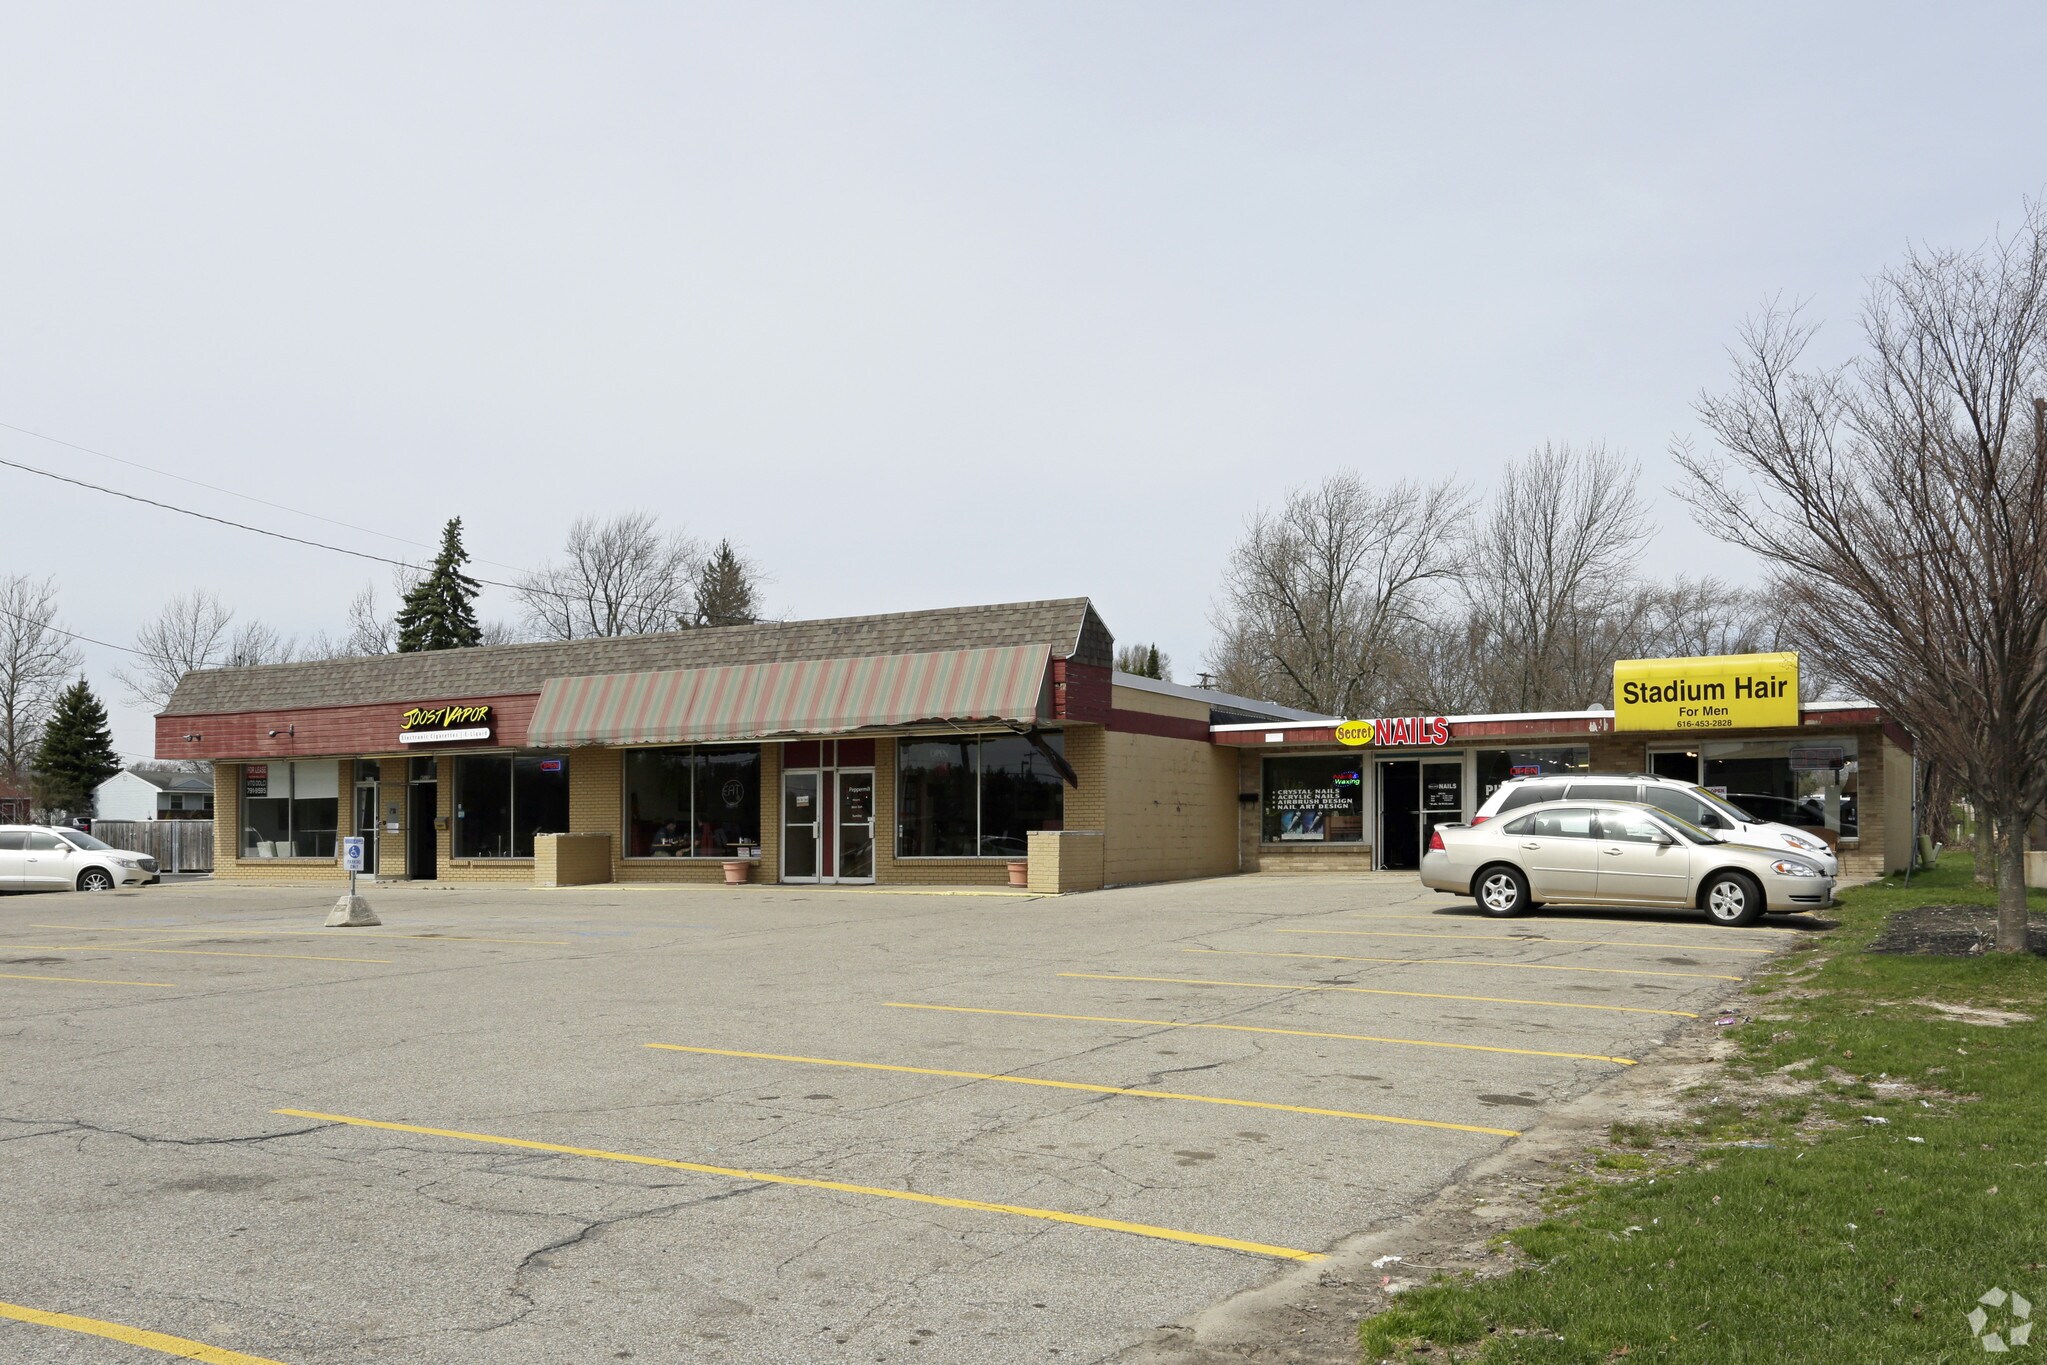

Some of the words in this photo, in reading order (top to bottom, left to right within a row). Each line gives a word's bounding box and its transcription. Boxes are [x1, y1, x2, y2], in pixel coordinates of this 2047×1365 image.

[1623, 679, 1725, 704] Stadium
[1735, 675, 1788, 699] Hair
[1679, 707, 1699, 716] For
[1703, 706, 1729, 716] Men
[1676, 719, 1732, 728] 616-453-2828
[1337, 726, 1372, 740] Secret
[1374, 716, 1449, 746] NAILS
[1509, 767, 1538, 775] OPEN
